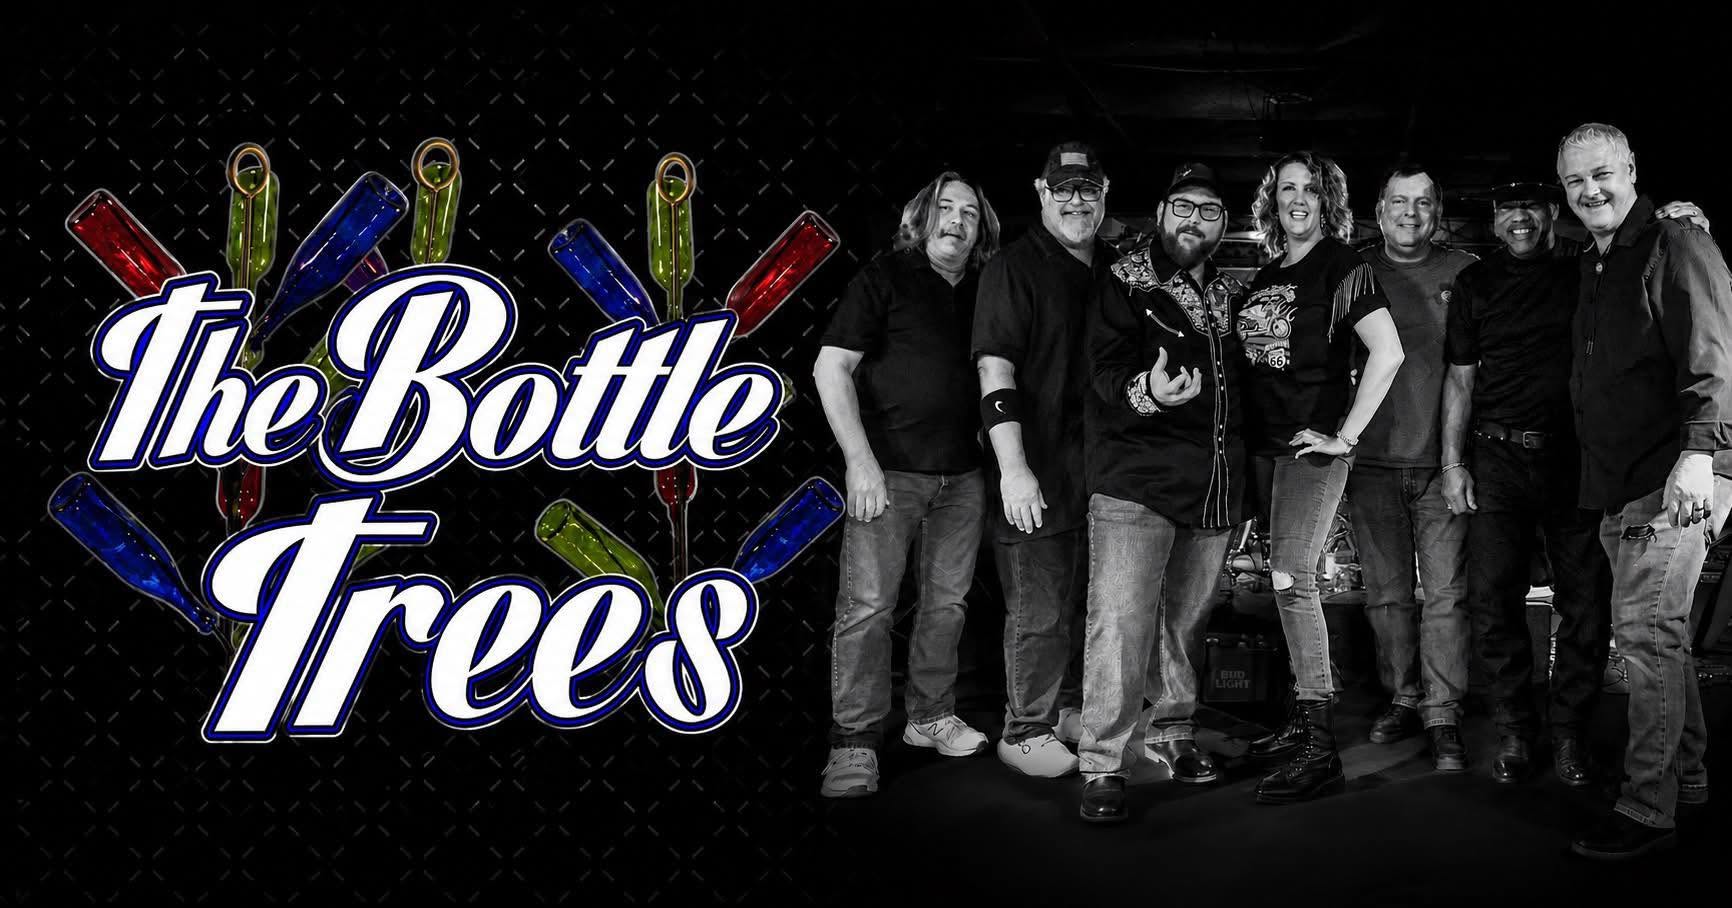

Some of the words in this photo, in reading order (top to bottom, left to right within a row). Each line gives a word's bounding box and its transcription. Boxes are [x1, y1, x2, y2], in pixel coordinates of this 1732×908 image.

[1270, 356, 1284, 366] 66
[1221, 671, 1245, 680] BUD
[1216, 680, 1249, 688] LIGHT
